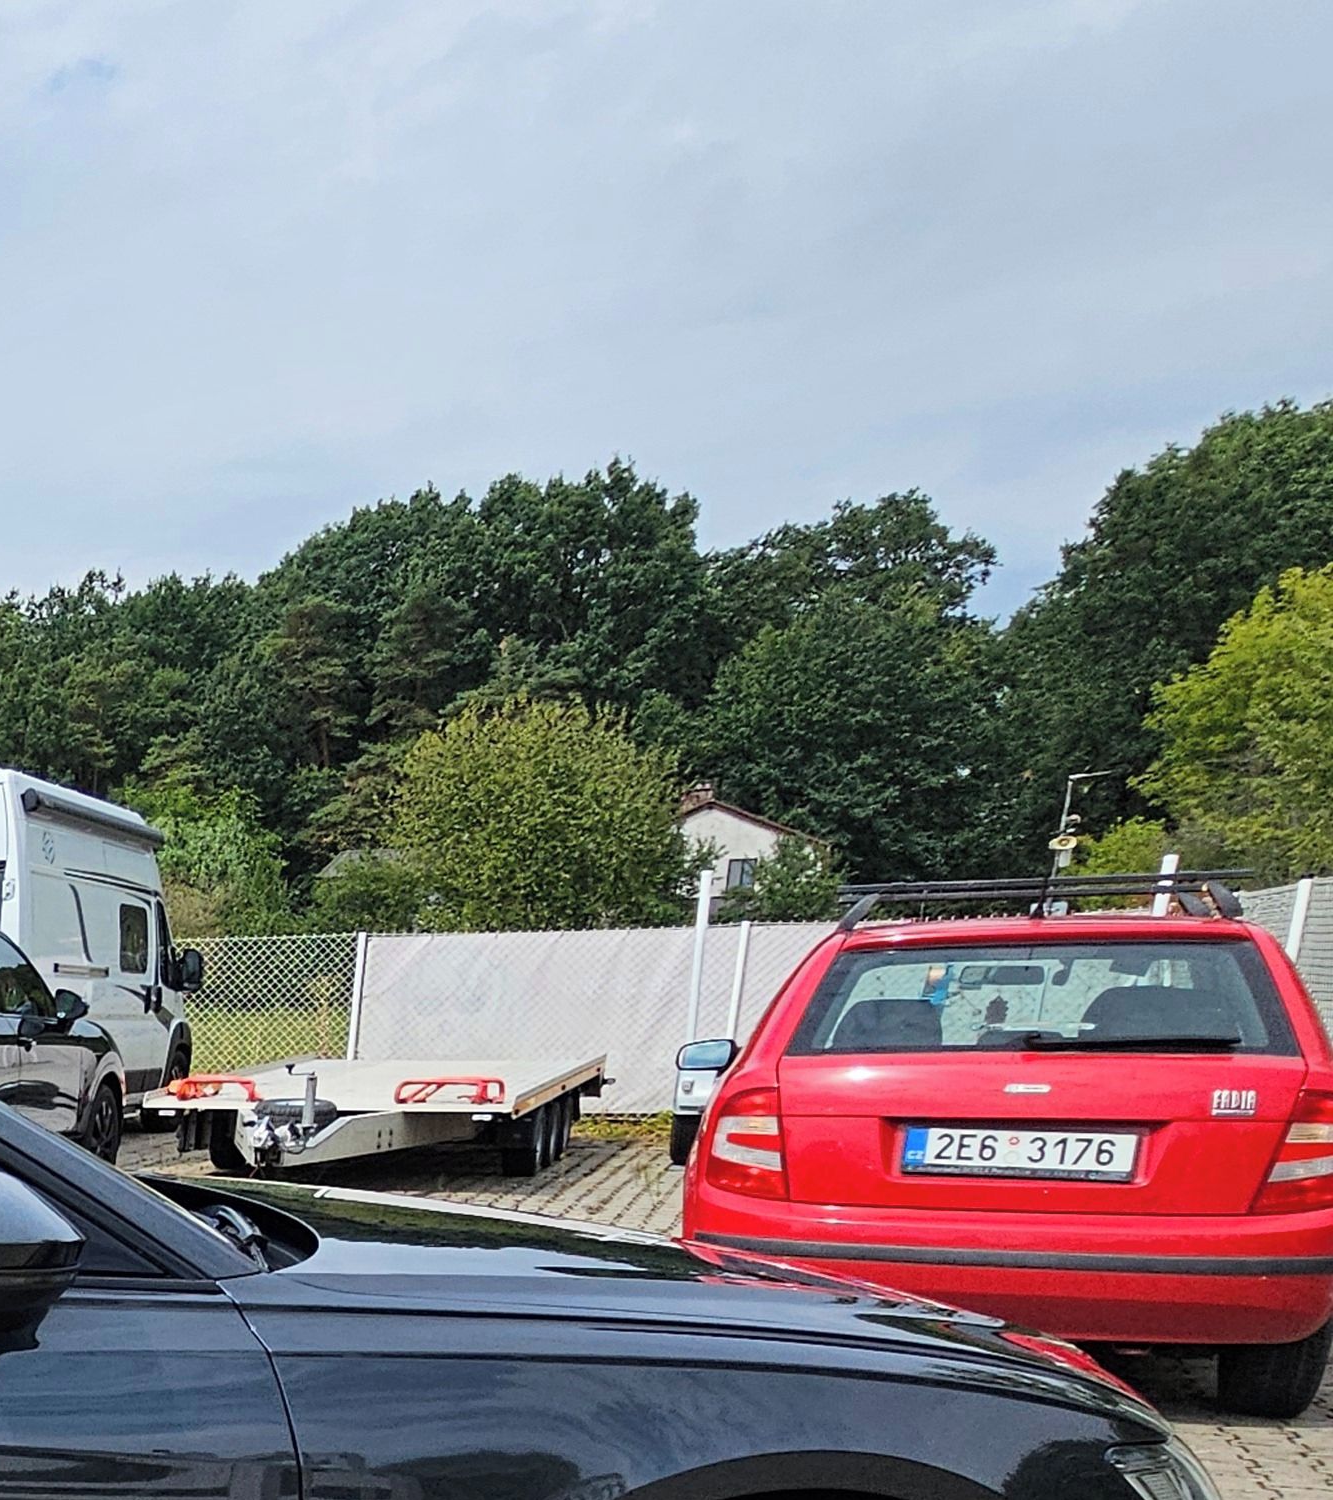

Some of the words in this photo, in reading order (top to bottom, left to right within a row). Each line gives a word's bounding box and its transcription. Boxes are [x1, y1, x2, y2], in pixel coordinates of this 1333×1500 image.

[1212, 1089, 1257, 1109] FABIA
[907, 1151, 925, 1160] CZ
[934, 1133, 999, 1161] 2E6
[1027, 1136, 1116, 1166] 3176
